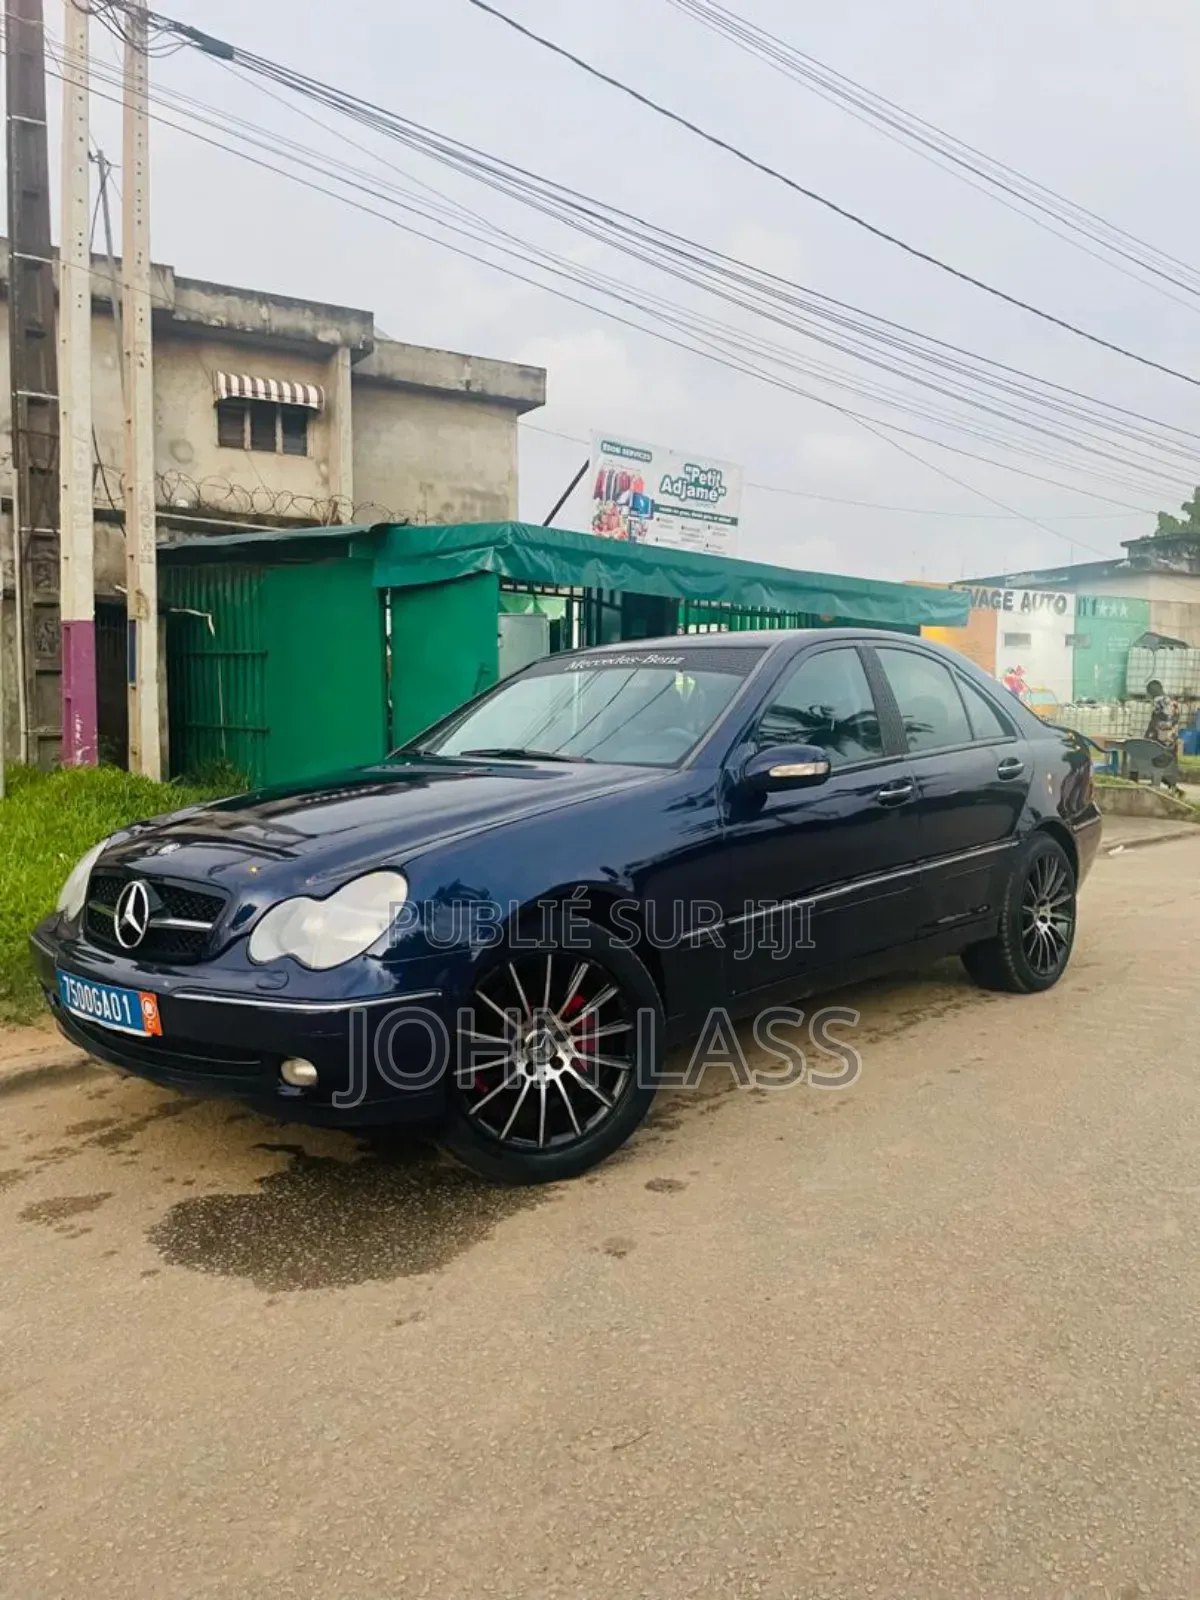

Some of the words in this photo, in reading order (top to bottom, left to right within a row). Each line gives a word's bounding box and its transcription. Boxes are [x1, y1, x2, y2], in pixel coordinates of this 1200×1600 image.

[967, 587, 1014, 612] VAGE
[1020, 591, 1068, 616] AUTO
[564, 654, 685, 671] Mercedes-Benz
[61, 975, 132, 1025] 7500GA01
